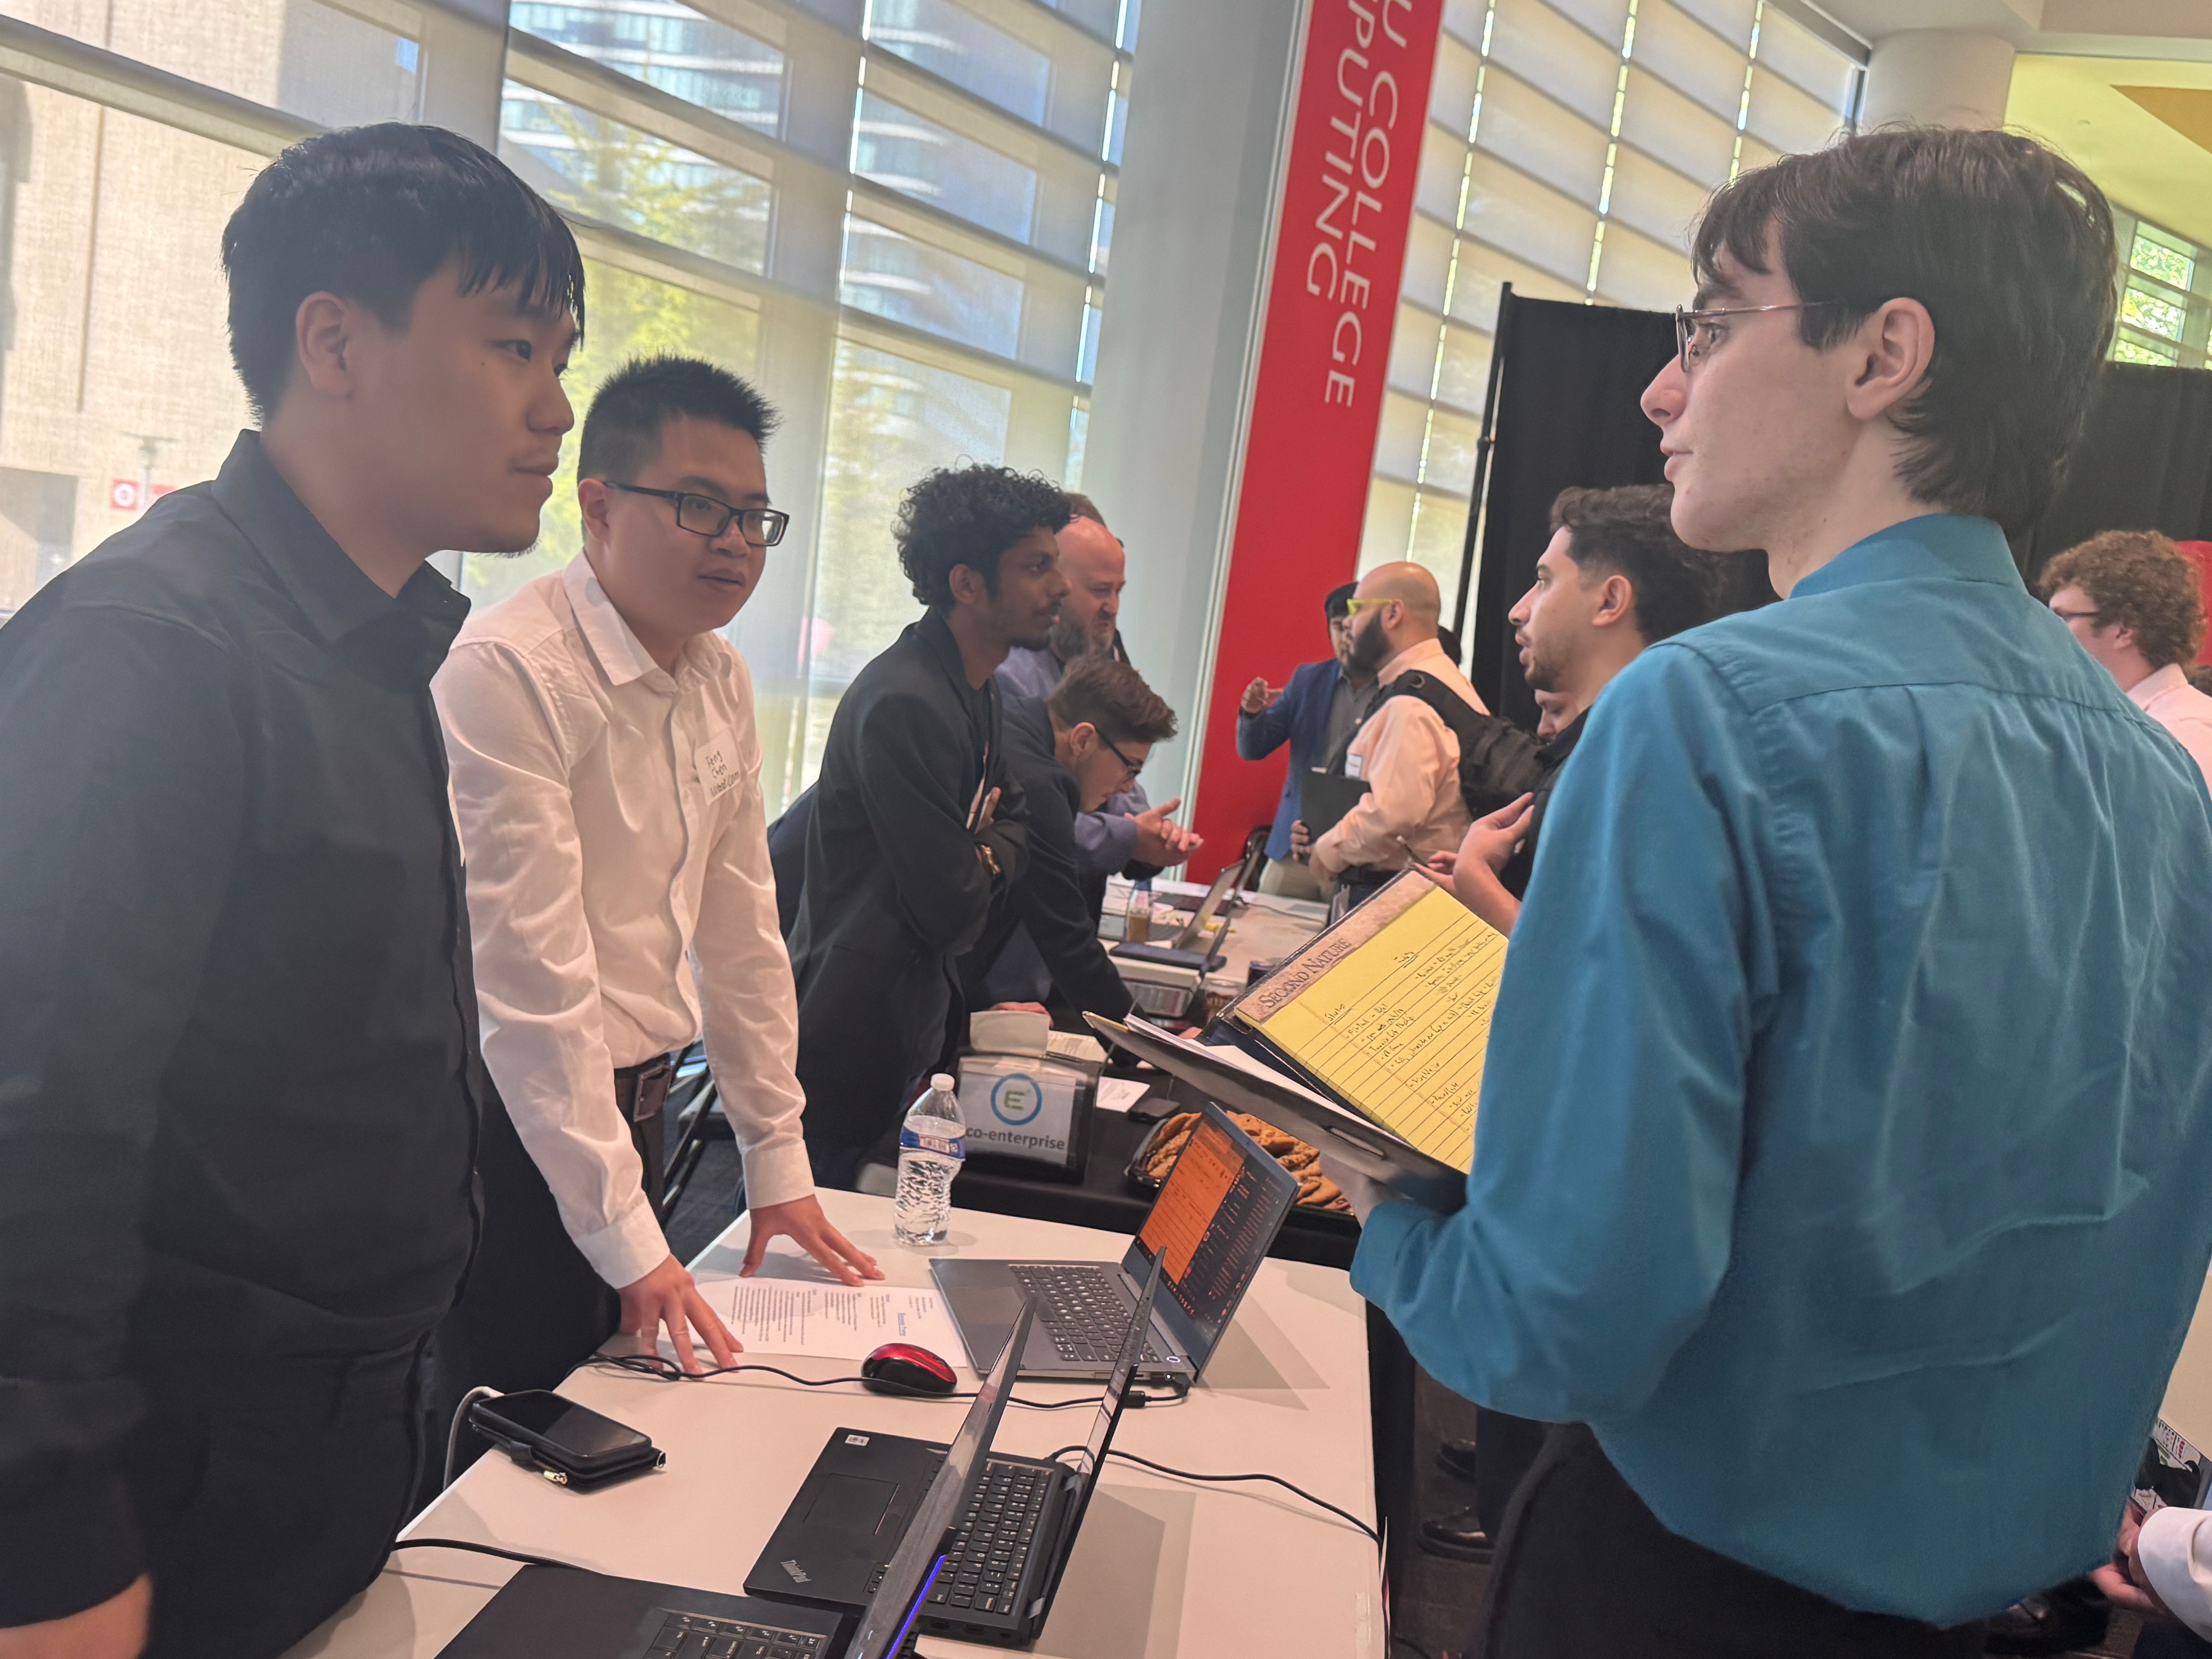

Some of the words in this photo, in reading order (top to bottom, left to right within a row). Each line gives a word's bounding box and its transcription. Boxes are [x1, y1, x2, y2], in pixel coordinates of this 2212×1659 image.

[1306, 0, 1377, 301] PUTING
[1324, 71, 1398, 407] COLLEGE
[1258, 971, 1309, 1008] SECOND
[1302, 938, 1352, 974] NATURE
[966, 1127, 1065, 1150] co-enterprise
